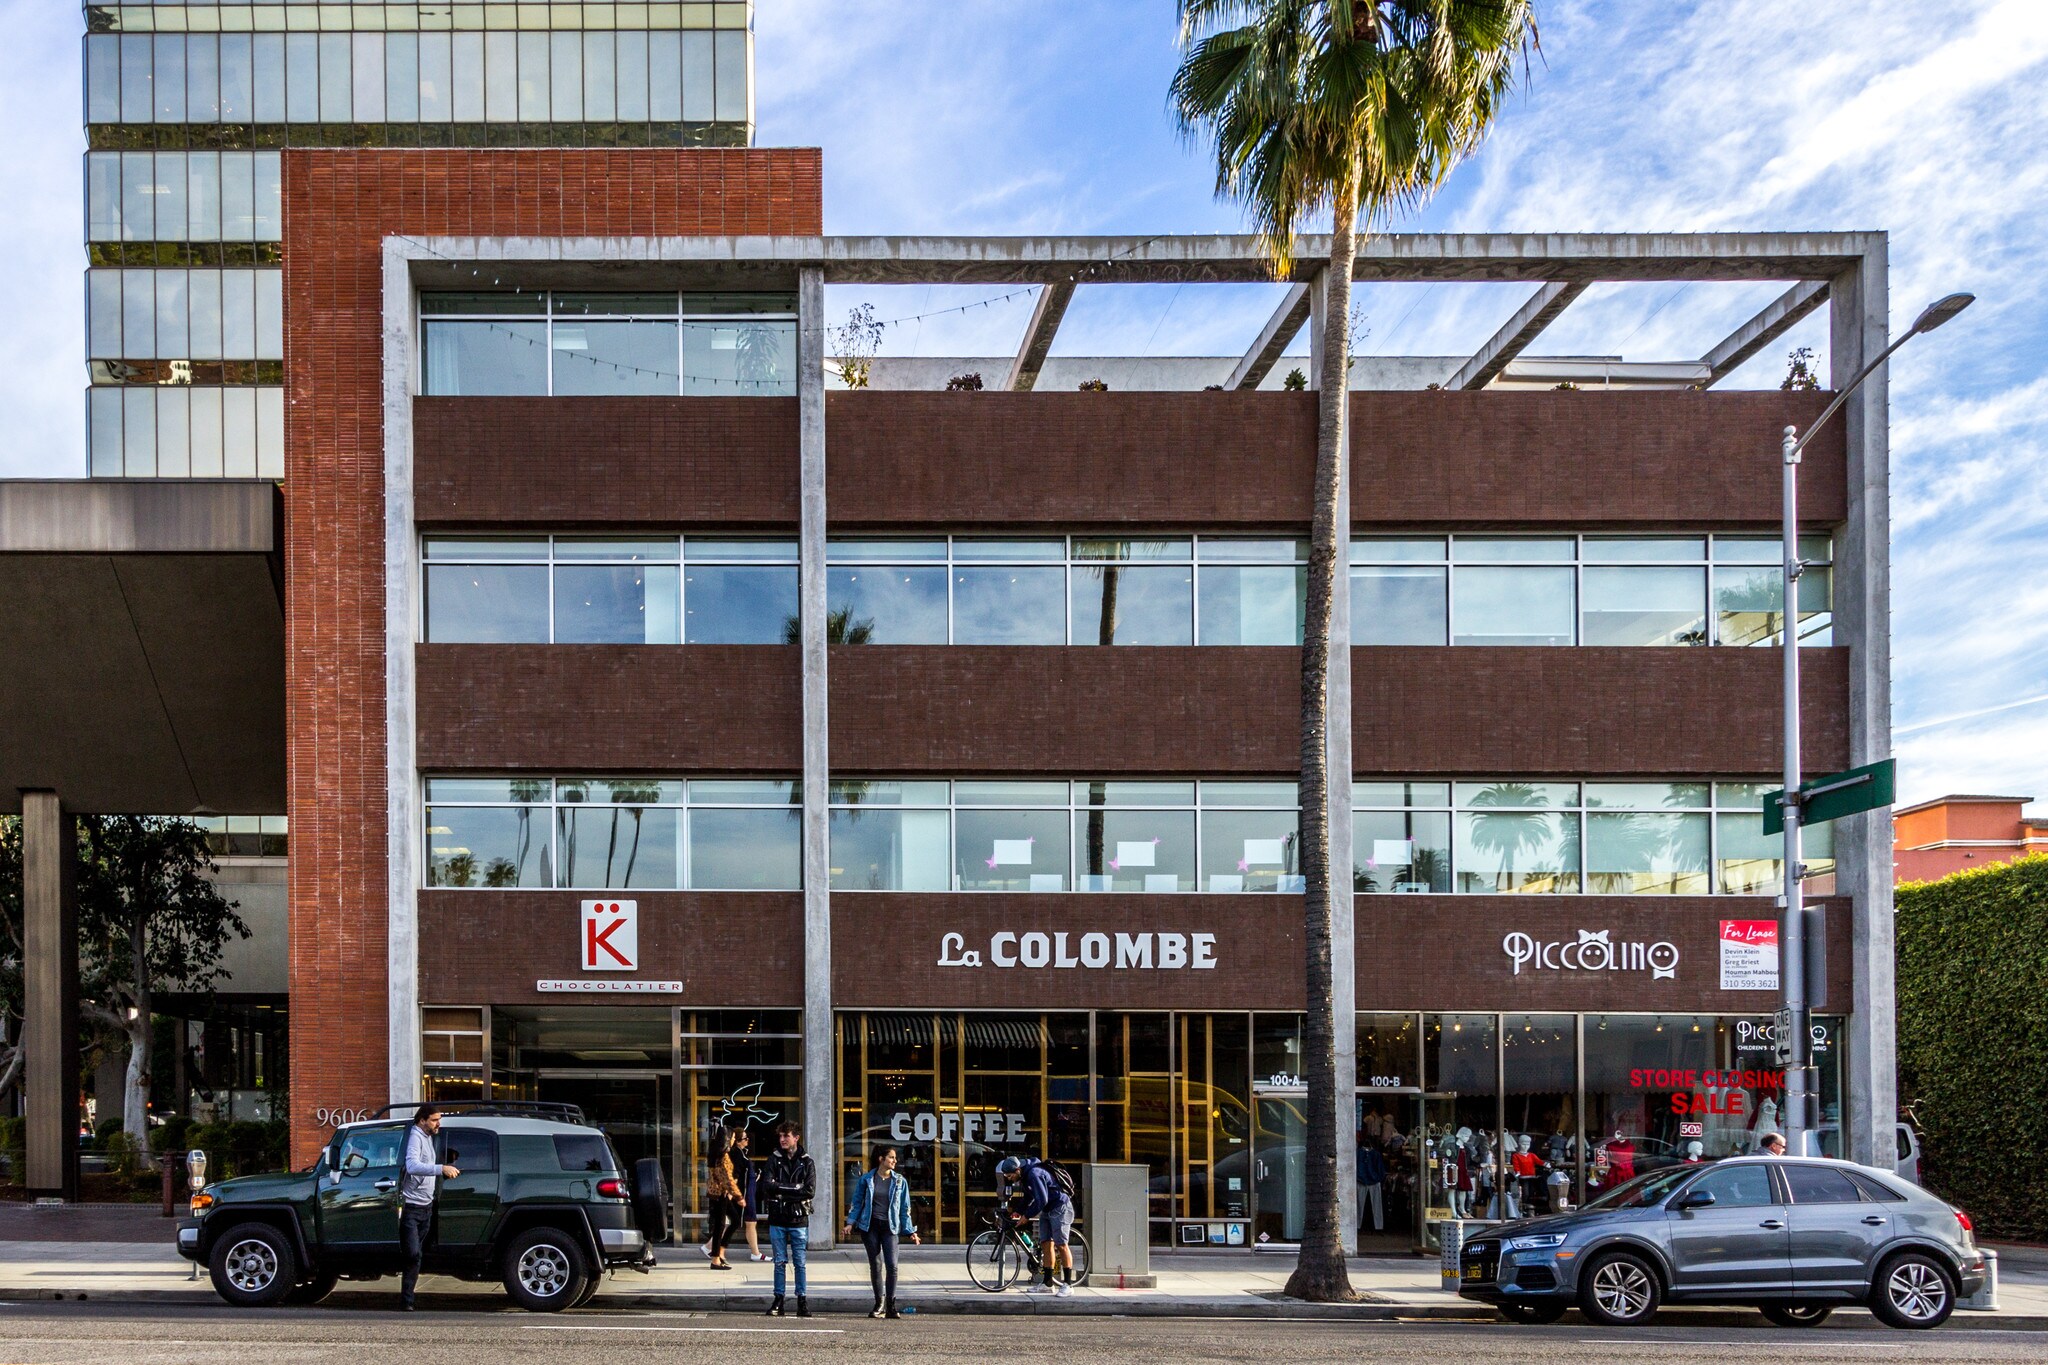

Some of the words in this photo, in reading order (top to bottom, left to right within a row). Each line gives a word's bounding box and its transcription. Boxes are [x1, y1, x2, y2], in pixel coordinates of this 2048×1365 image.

[1724, 924, 1744, 938] For
[1746, 925, 1776, 940] Lease
[937, 932, 982, 967] La
[990, 931, 1217, 969] COLOMBE
[539, 982, 681, 992] CHOCOLATIER
[1724, 980, 1739, 988] 310
[1741, 980, 1756, 988] 595
[1758, 980, 1777, 988] 3621
[1775, 1012, 1789, 1028] ONE
[1776, 1029, 1790, 1043] WAY
[1270, 1075, 1300, 1086] 100-A
[1371, 1076, 1400, 1087] 100-B
[1629, 1069, 1697, 1087] STORE
[1671, 1092, 1744, 1114] SALE
[316, 1107, 368, 1127] 9606
[890, 1112, 1027, 1143] COFFEE
[1231, 1224, 1240, 1235] A
